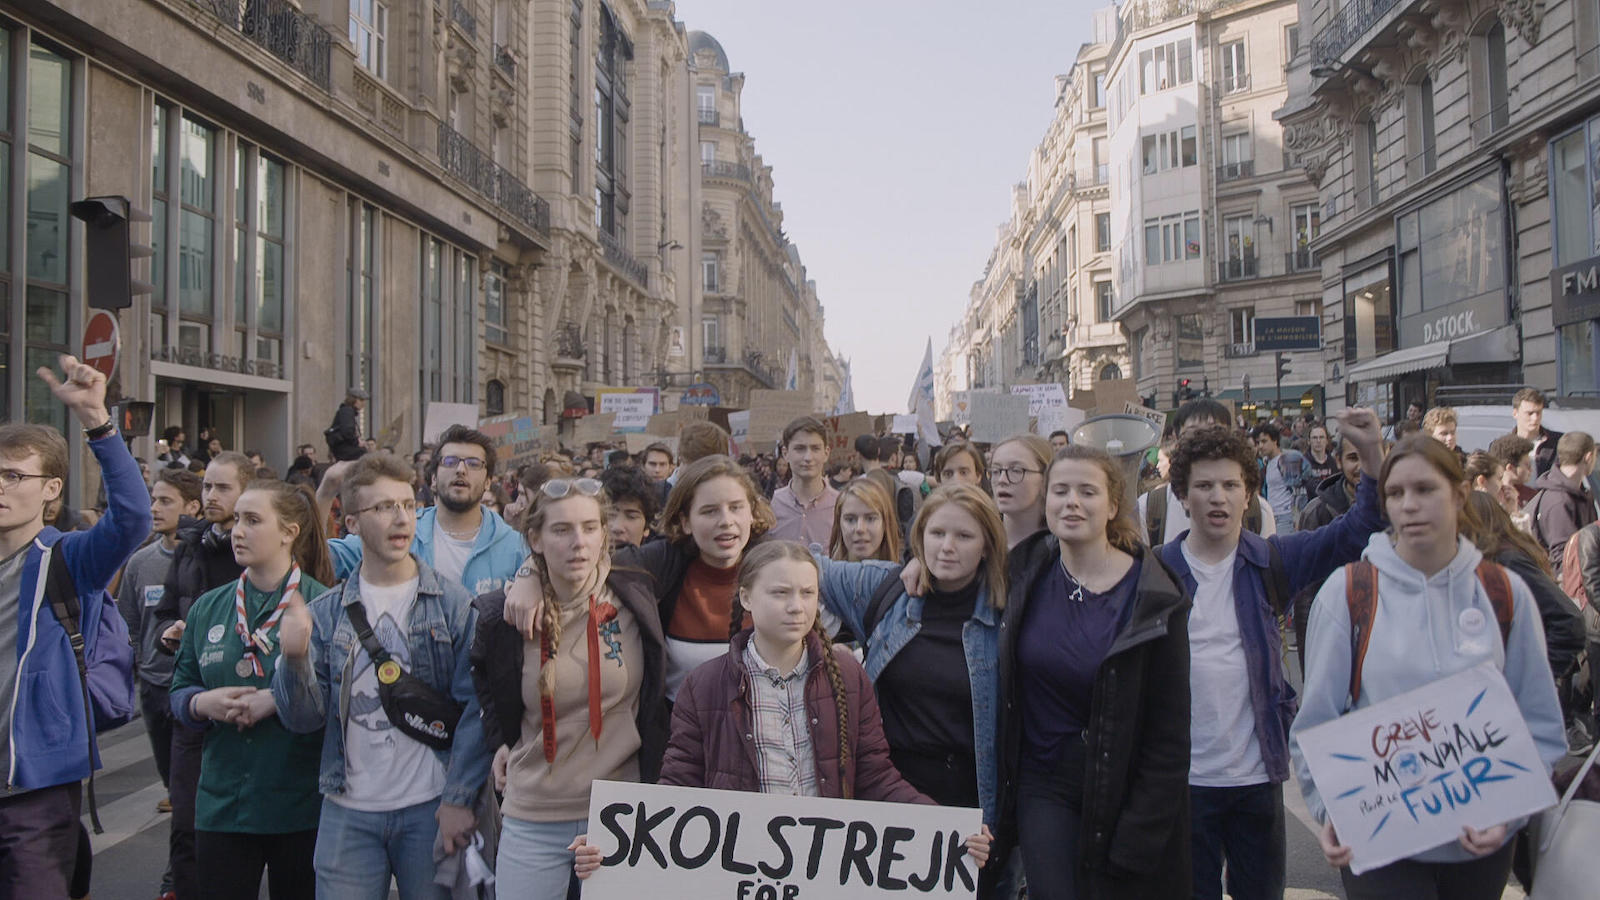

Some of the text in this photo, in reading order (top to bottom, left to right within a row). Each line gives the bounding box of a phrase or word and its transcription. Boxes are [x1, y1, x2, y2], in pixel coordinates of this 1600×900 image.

[1424, 310, 1473, 344] D.STOCK
[600, 801, 975, 892] SKOLSTREJK
[737, 878, 799, 900] FÖR
